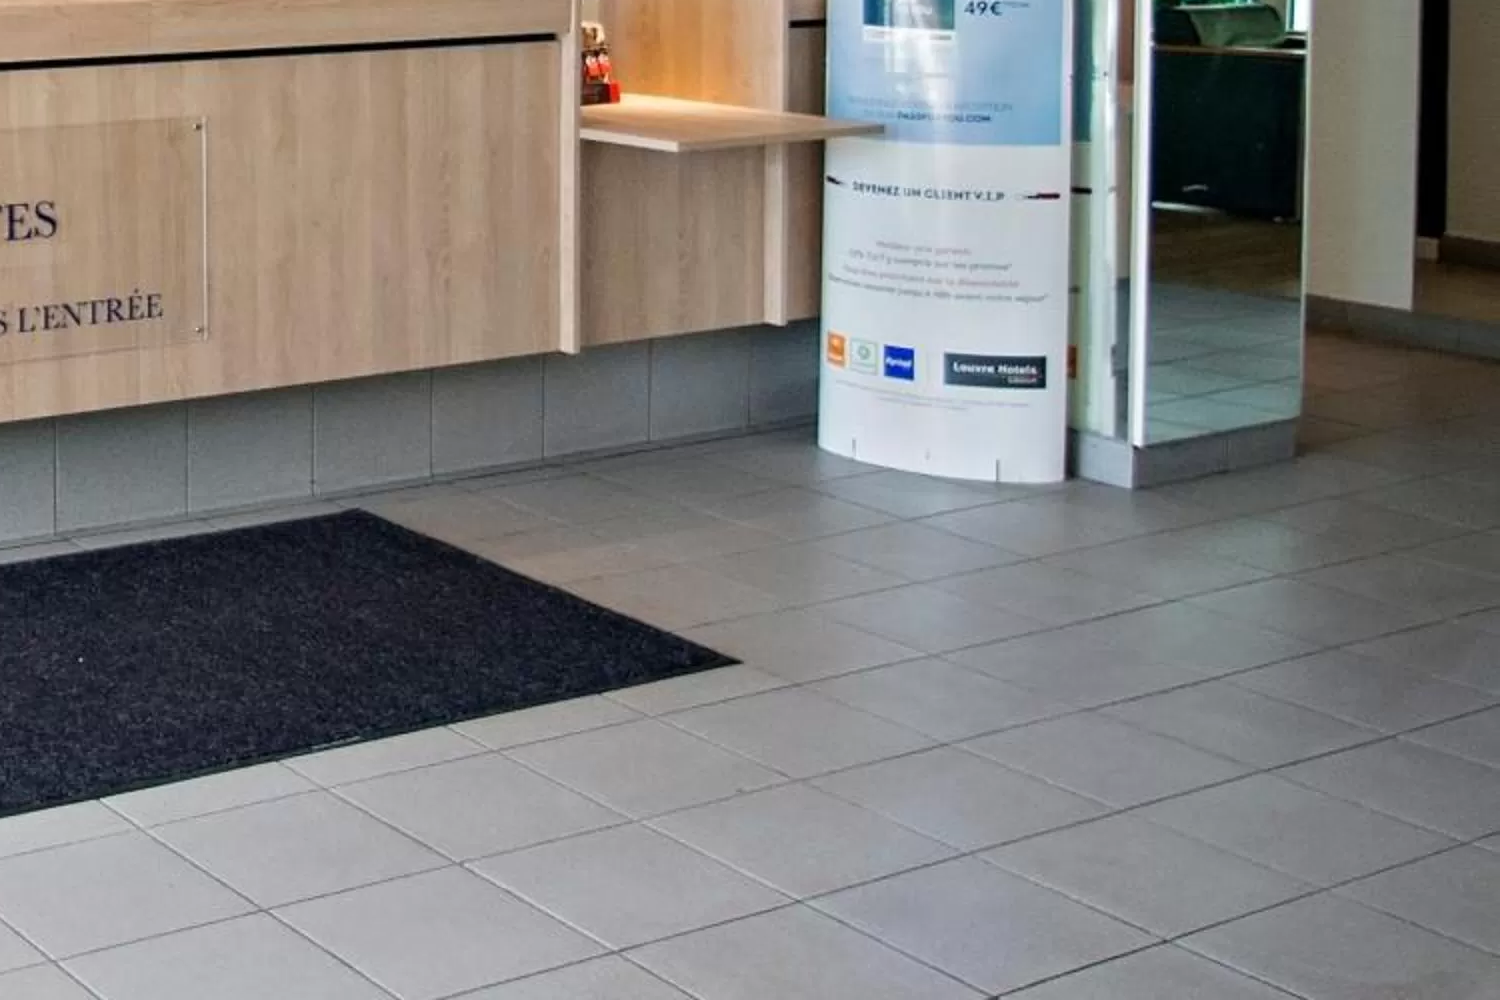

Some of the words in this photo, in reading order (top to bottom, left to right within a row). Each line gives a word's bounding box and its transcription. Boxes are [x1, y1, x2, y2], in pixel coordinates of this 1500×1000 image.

[963, 0, 1003, 17] 49€
[852, 181, 900, 197] DEVENEZ
[903, 188, 922, 198] UN
[924, 188, 971, 201] CLIENT
[18, 287, 165, 334] L'ENTRÉE
[953, 360, 995, 374] Louvre
[997, 362, 1038, 375] Hotels
